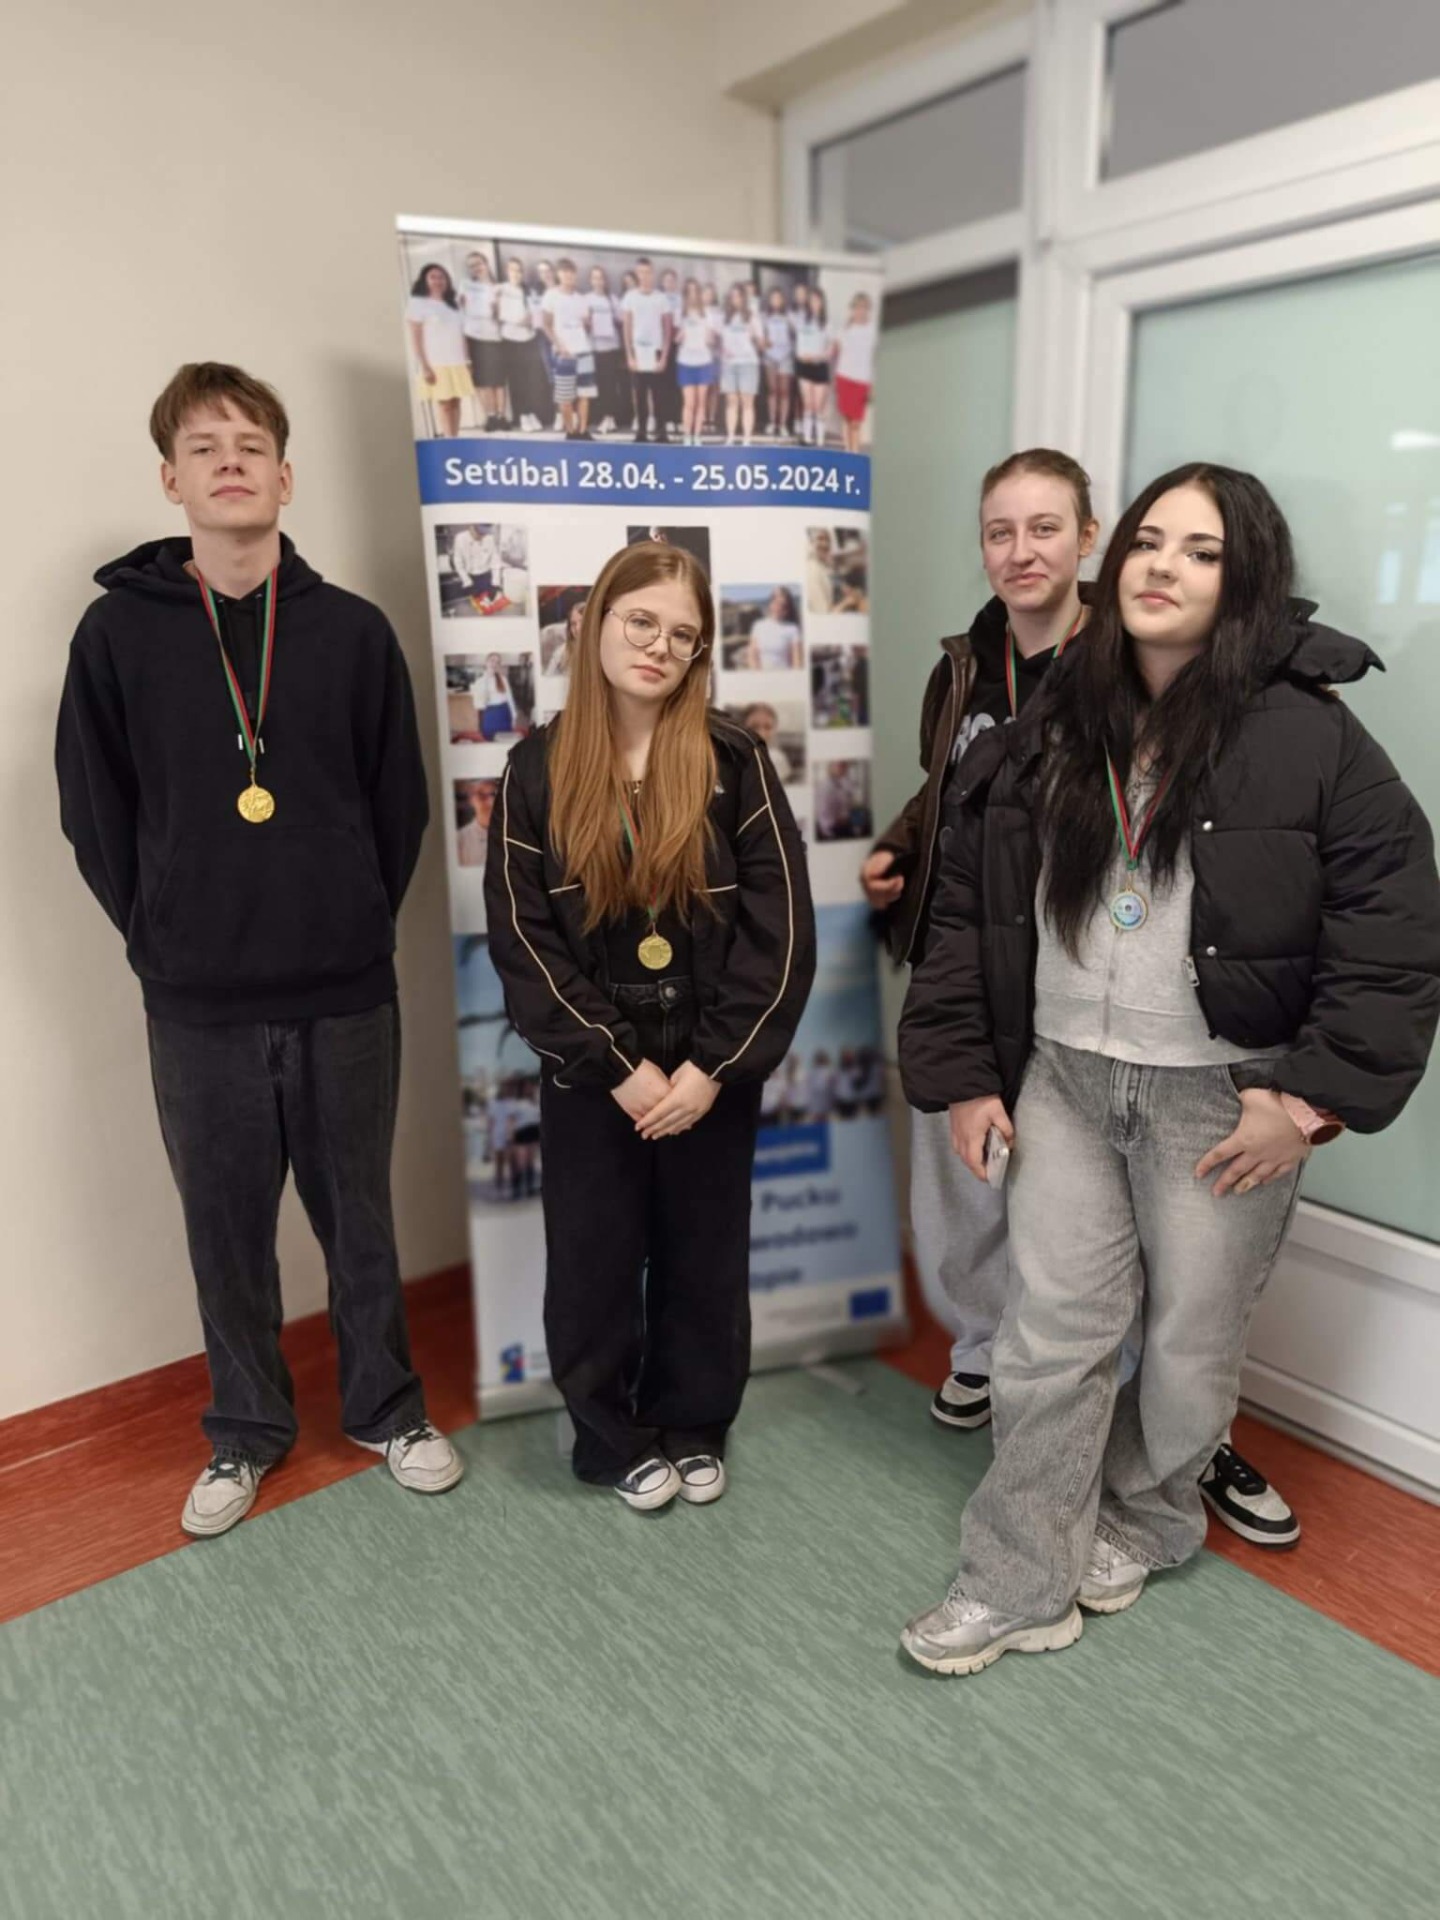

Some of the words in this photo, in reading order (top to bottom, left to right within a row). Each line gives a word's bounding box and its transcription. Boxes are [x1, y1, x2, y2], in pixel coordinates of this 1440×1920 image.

[445, 457, 569, 488] Setúbal
[578, 461, 666, 490] 28.04.
[691, 464, 840, 493] 25.05.2024
[845, 474, 861, 496] r.
